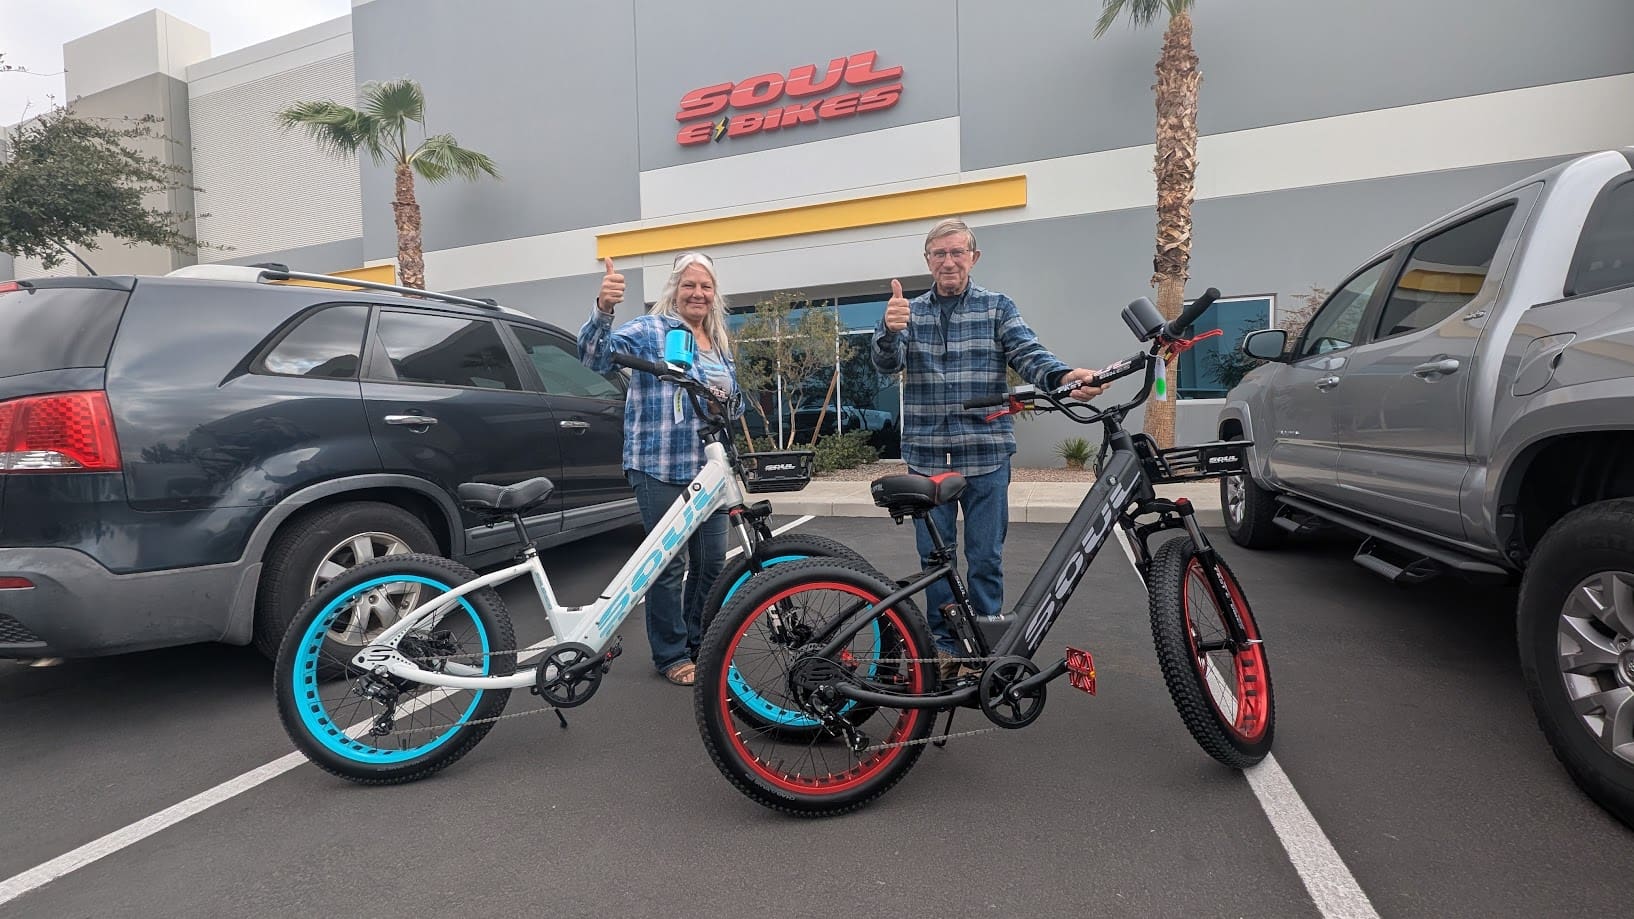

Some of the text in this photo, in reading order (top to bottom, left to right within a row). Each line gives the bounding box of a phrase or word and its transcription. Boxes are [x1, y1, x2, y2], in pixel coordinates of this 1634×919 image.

[676, 50, 903, 122] SOUL
[727, 82, 904, 139] BIKES
[598, 476, 726, 638] SOUL
[1025, 471, 1141, 650] SOUL
